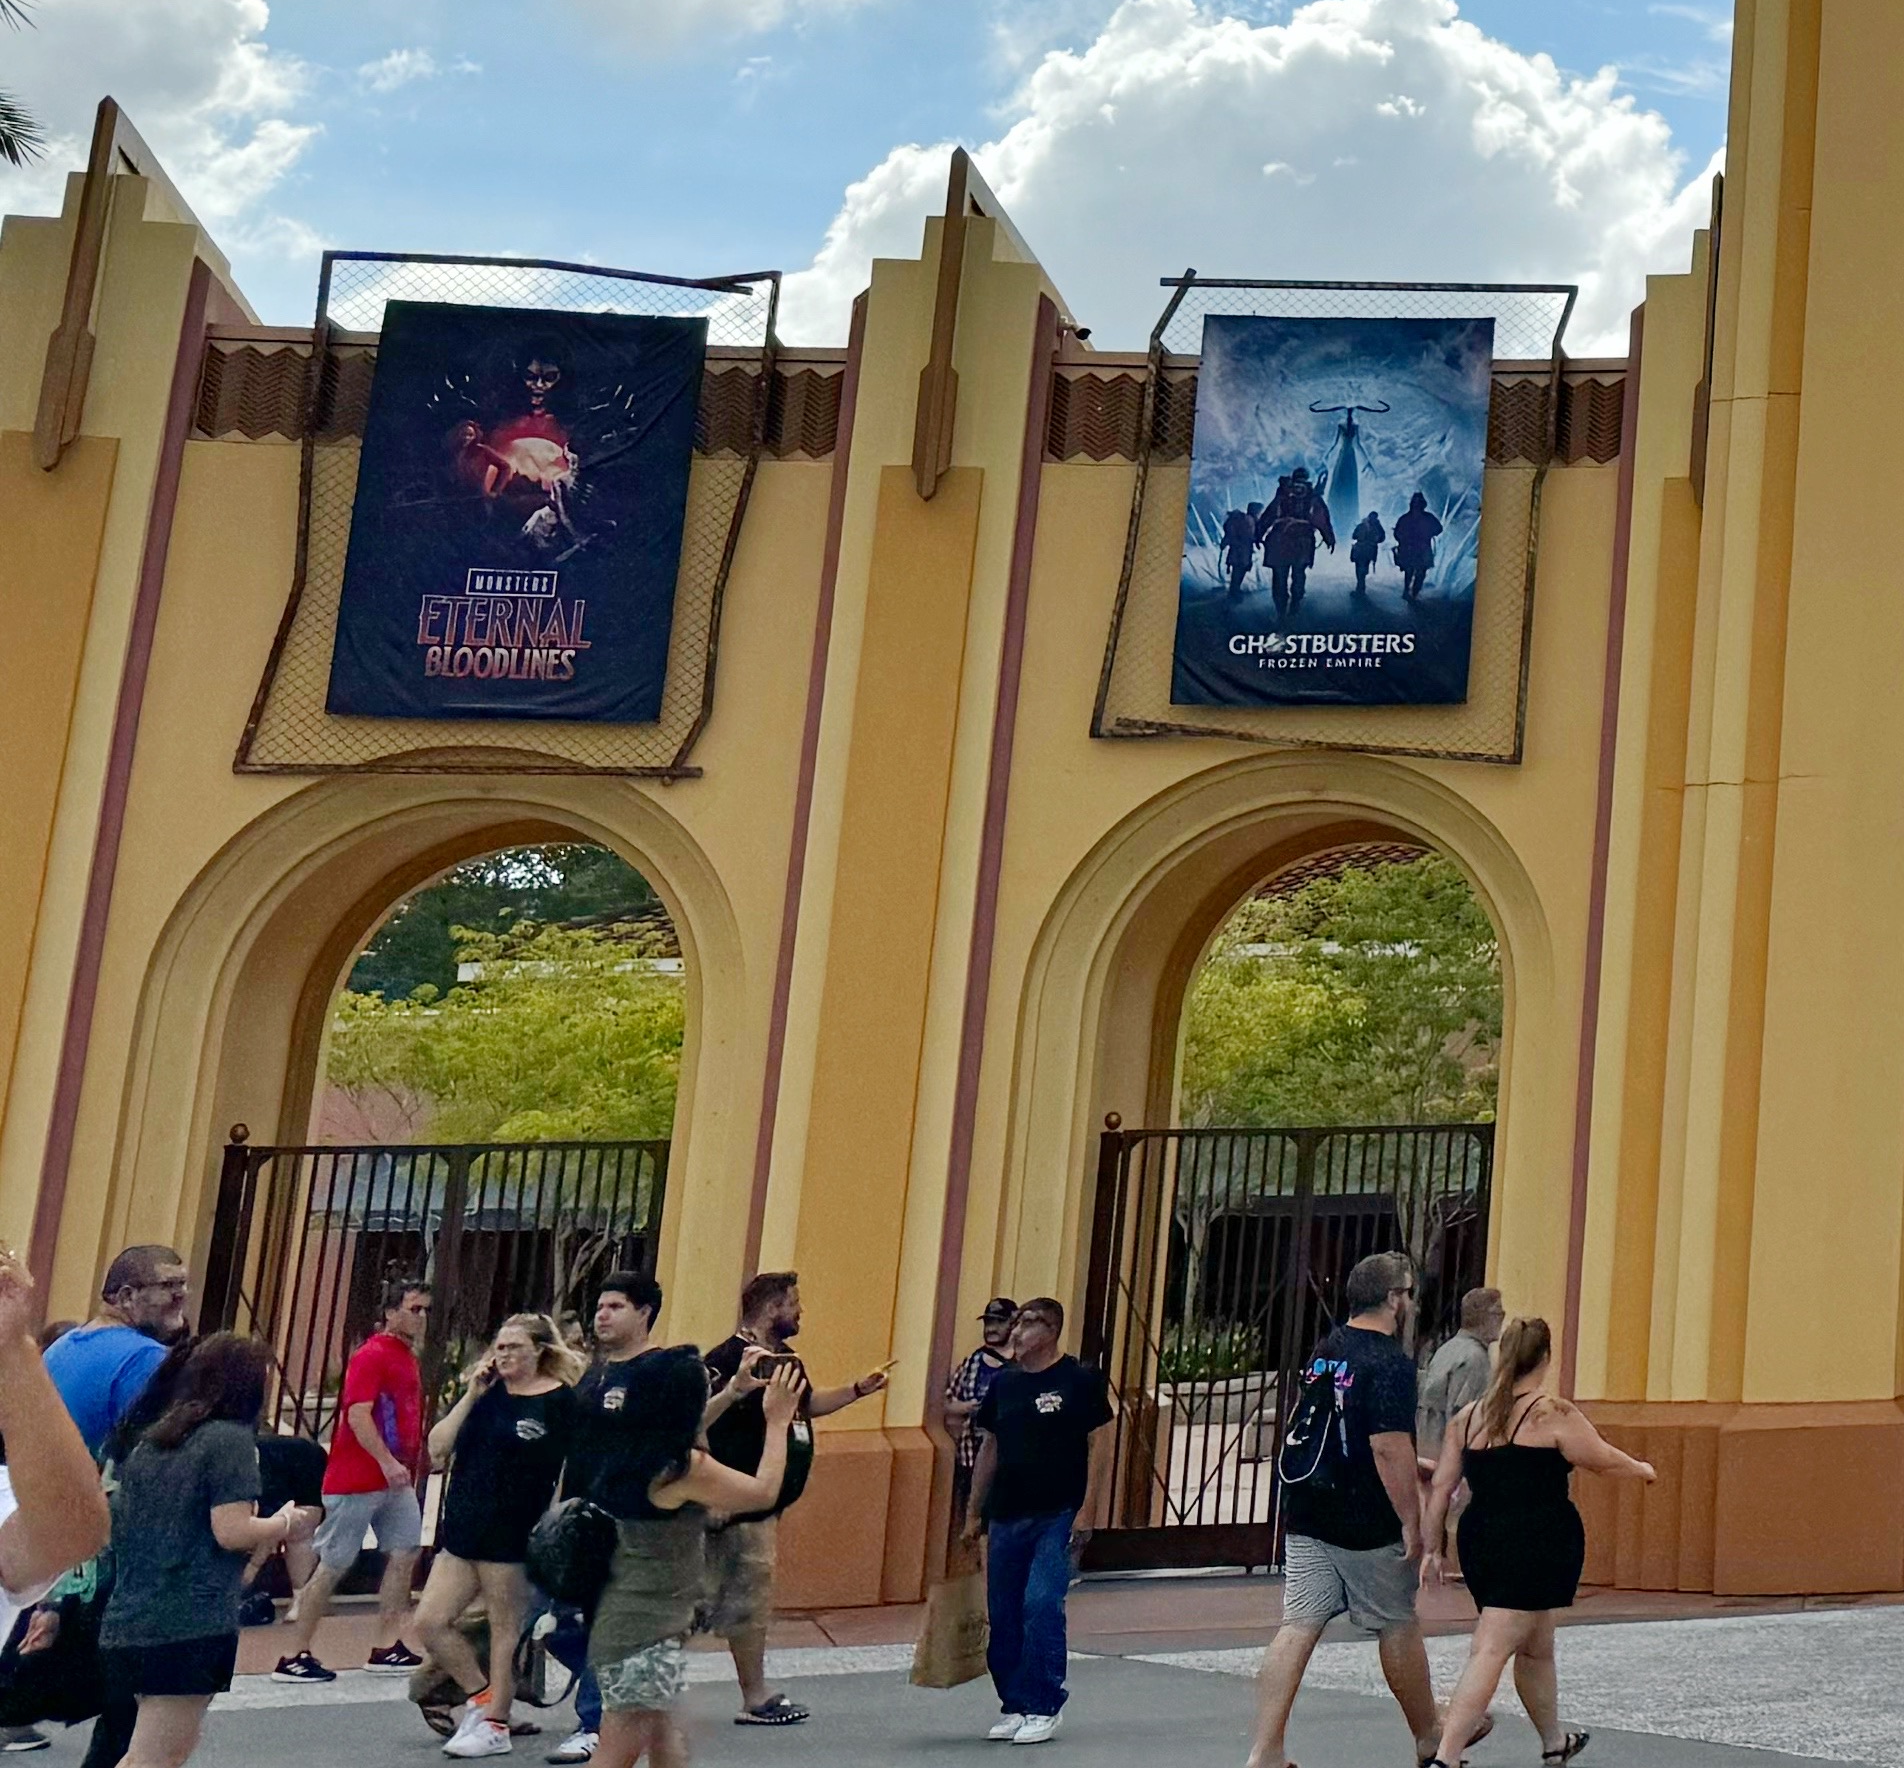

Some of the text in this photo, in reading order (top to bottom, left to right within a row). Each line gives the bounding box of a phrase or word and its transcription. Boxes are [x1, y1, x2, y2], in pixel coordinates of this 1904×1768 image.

[475, 575, 549, 592] MONSTERS
[417, 594, 591, 648] ETERNAL
[424, 646, 577, 680] BLOODLINES
[1258, 657, 1382, 669] FROZEN EMPIRE
